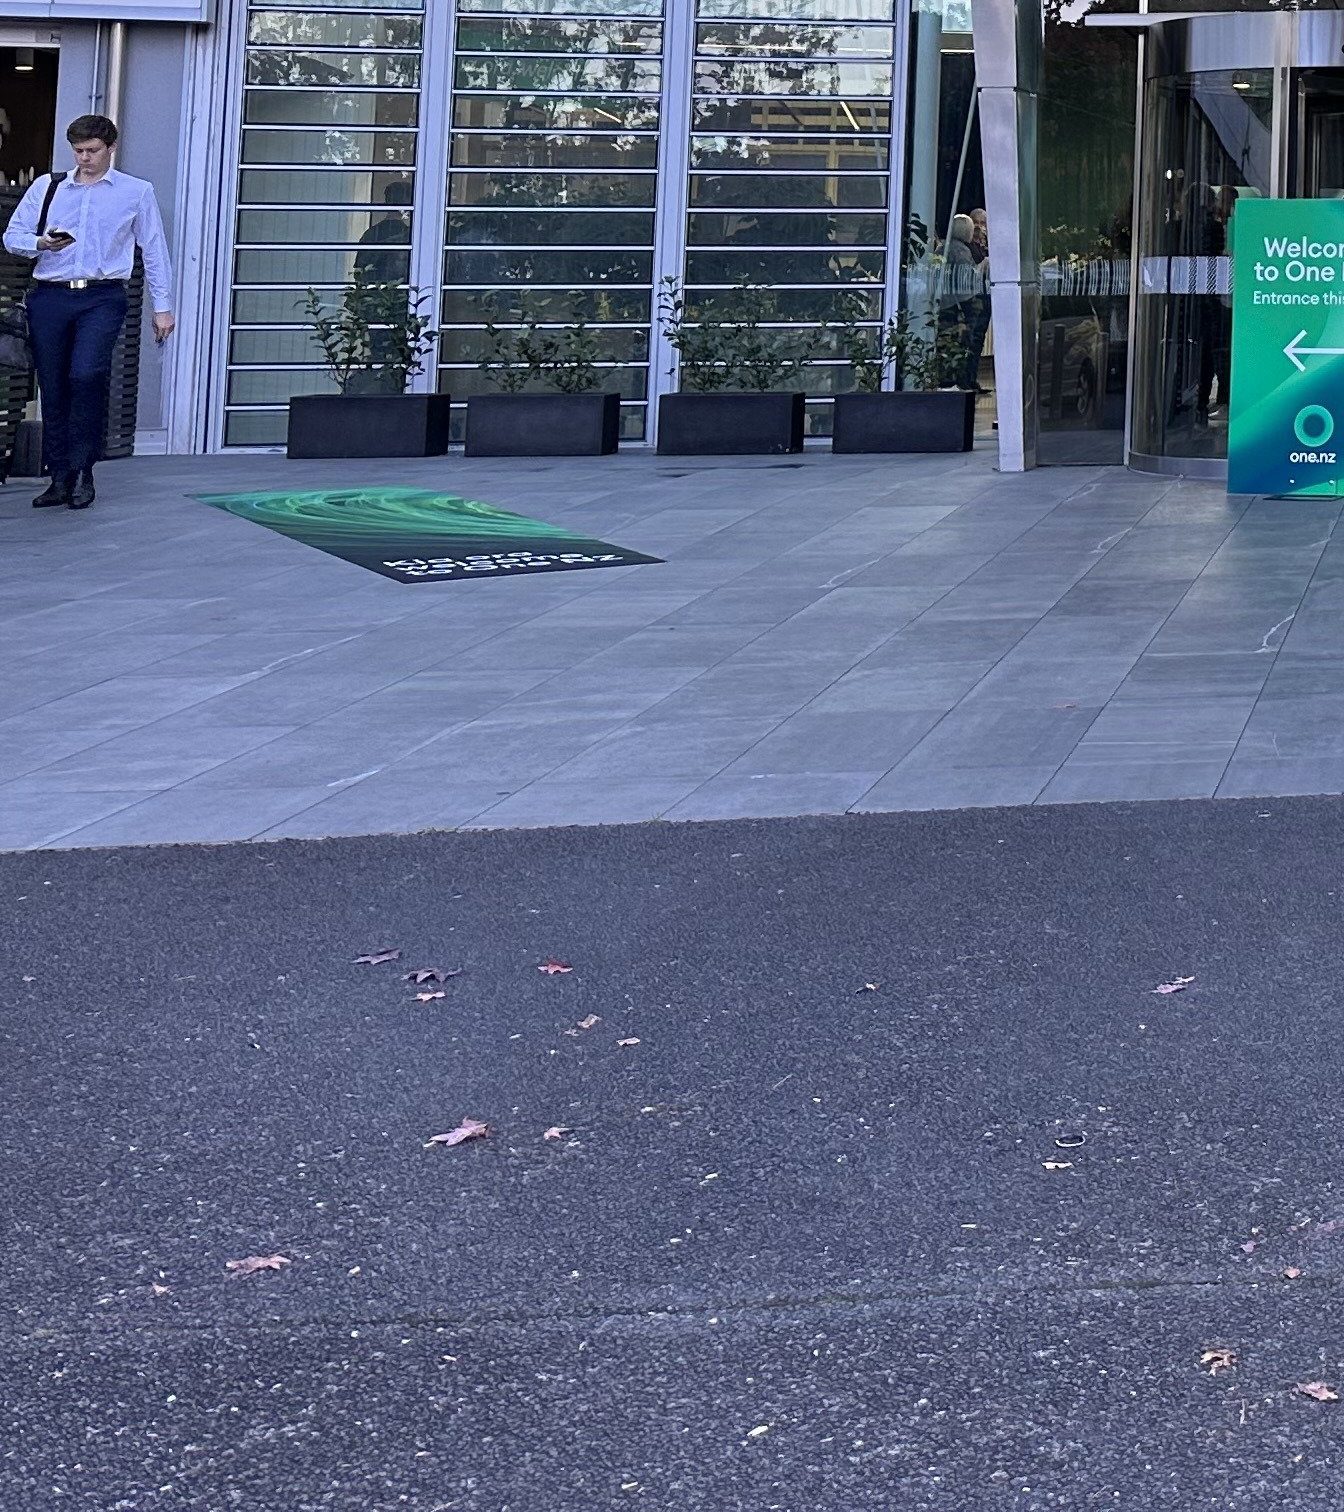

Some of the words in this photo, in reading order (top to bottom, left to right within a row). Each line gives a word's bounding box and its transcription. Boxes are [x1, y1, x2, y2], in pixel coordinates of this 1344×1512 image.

[1253, 261, 1279, 282] to
[1285, 260, 1335, 282] One
[1253, 290, 1320, 305] Entrance
[1289, 452, 1337, 464] one.nz
